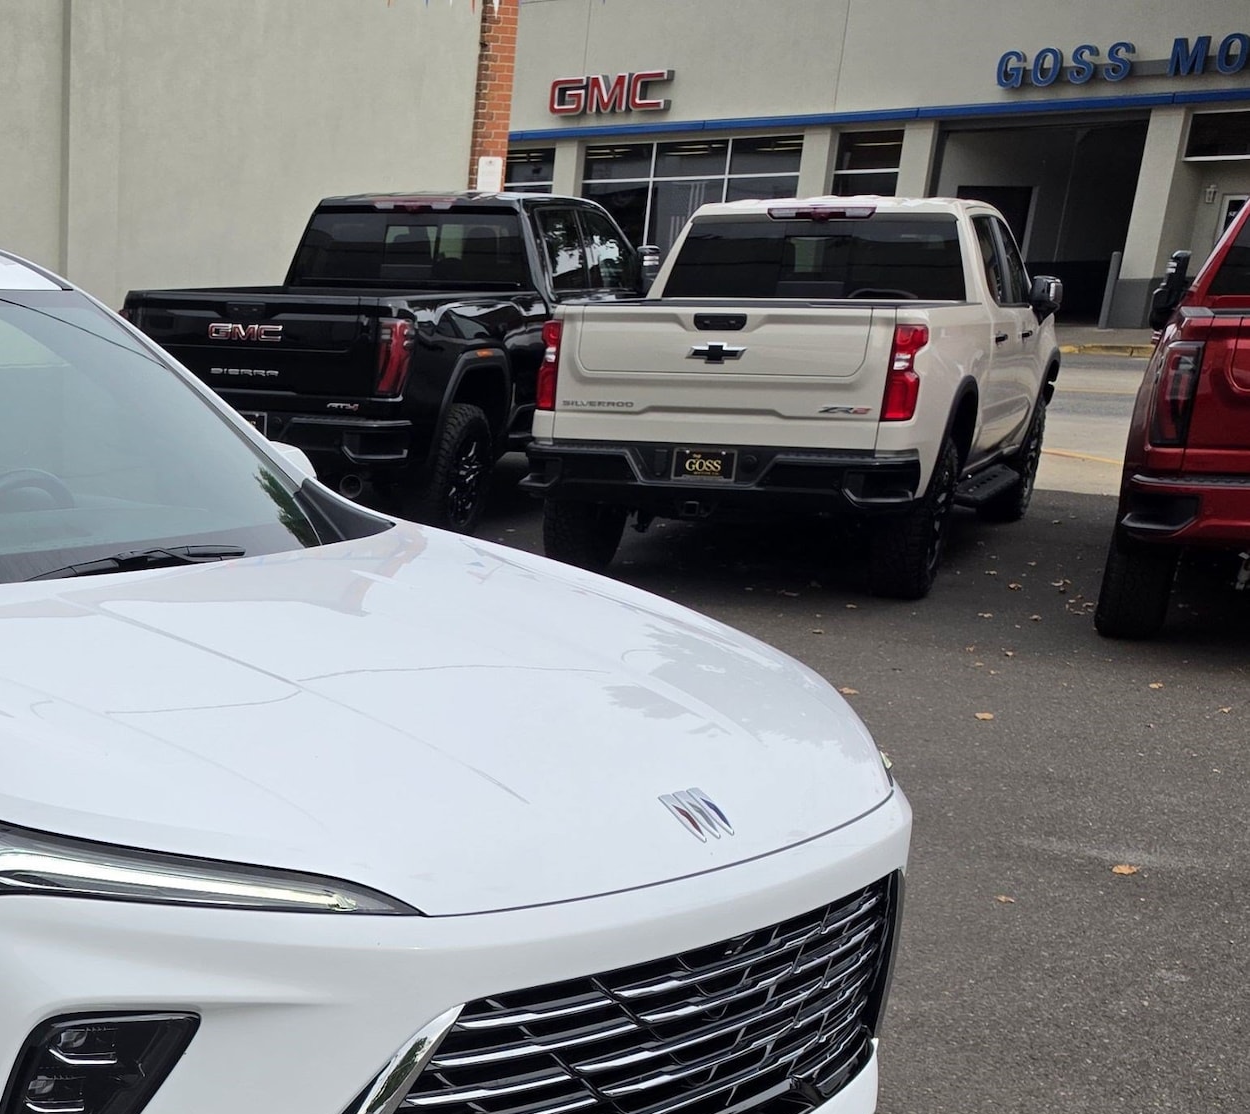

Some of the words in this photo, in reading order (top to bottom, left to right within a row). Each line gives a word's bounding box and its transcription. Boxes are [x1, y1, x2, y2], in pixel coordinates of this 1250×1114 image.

[996, 41, 1136, 89] GOSS
[548, 70, 671, 115] GMC
[208, 322, 283, 342] GMC
[210, 367, 279, 377] SIERRA
[685, 459, 721, 471] GOSS
